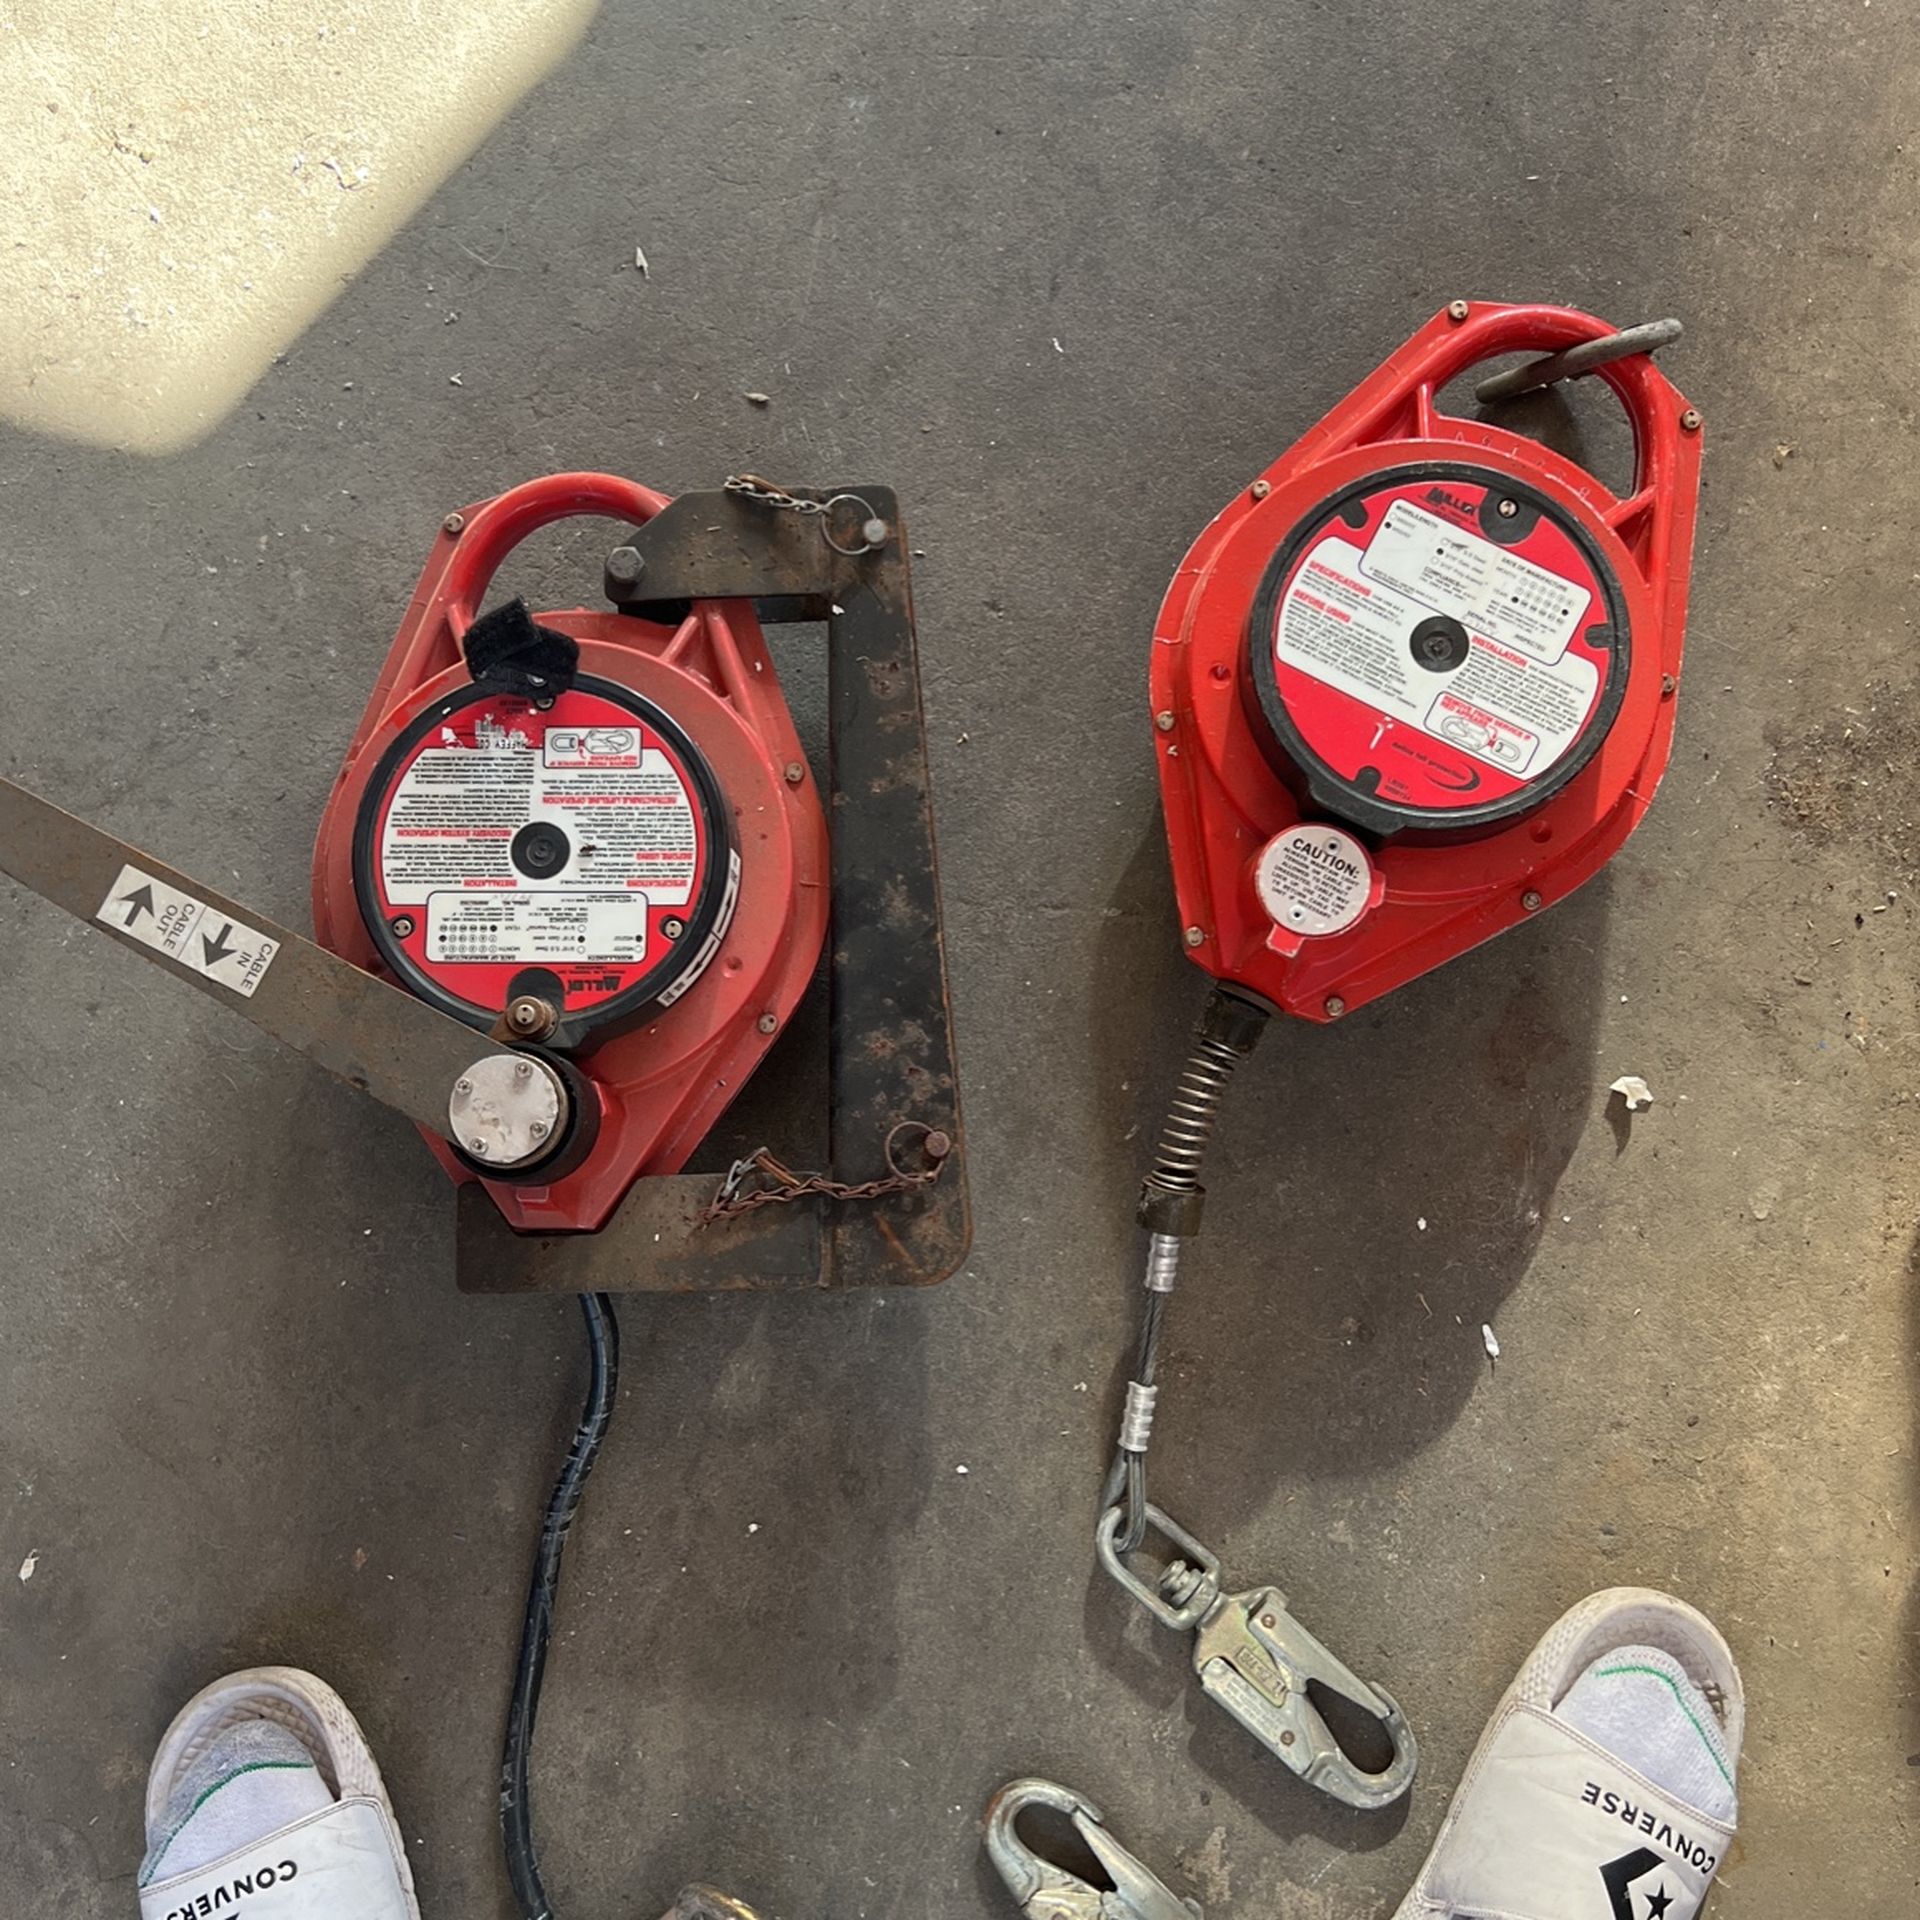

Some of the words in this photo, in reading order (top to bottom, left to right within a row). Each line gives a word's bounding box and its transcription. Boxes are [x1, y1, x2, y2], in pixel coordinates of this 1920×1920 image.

[1470, 635, 1527, 667] INSTALLATION
[1291, 836, 1361, 879] CAUTION:
[157, 904, 179, 934] OUT
[163, 903, 195, 950] CABLE
[238, 951, 252, 968] IN
[241, 943, 273, 990] CABLE
[1581, 1781, 1716, 1875] CONVERSE
[166, 1860, 298, 1920] CONVER
